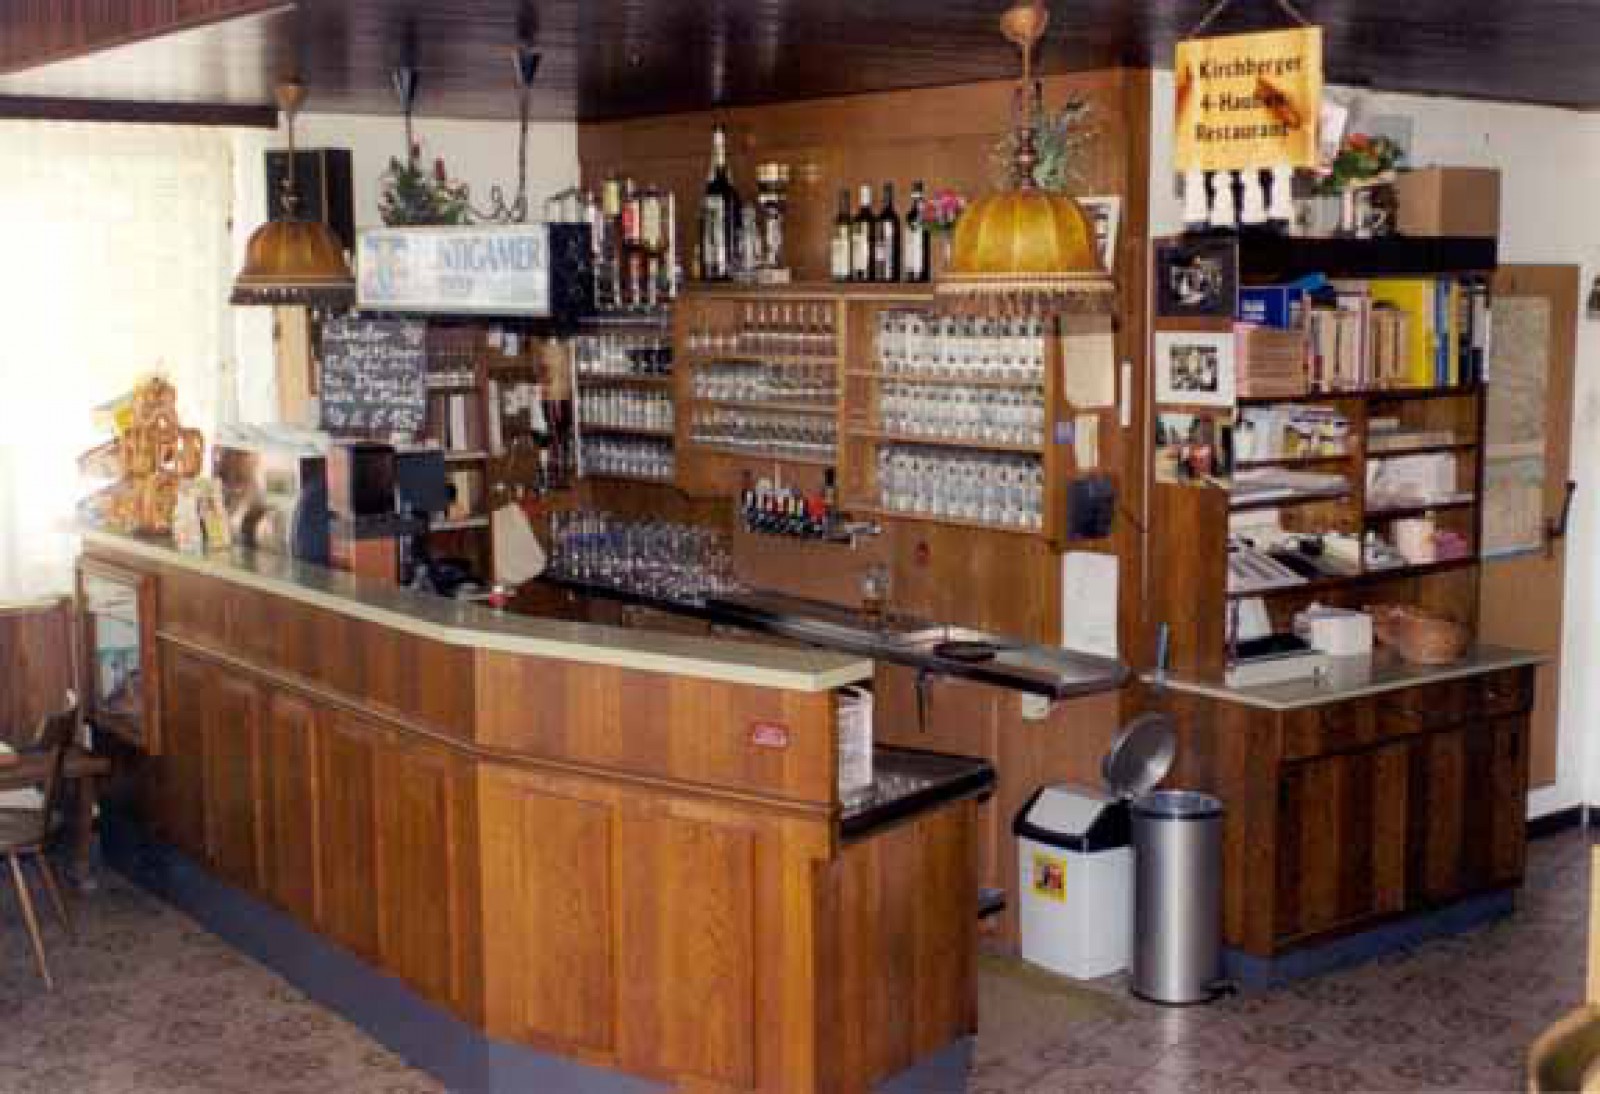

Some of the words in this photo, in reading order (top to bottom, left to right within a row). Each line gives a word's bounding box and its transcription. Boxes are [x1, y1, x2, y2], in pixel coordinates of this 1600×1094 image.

[1199, 56, 1301, 79] Kirchberger
[1200, 91, 1282, 112] 4-Hau
[1195, 121, 1290, 141] Restaurant
[410, 234, 541, 270] NTIGAMER
